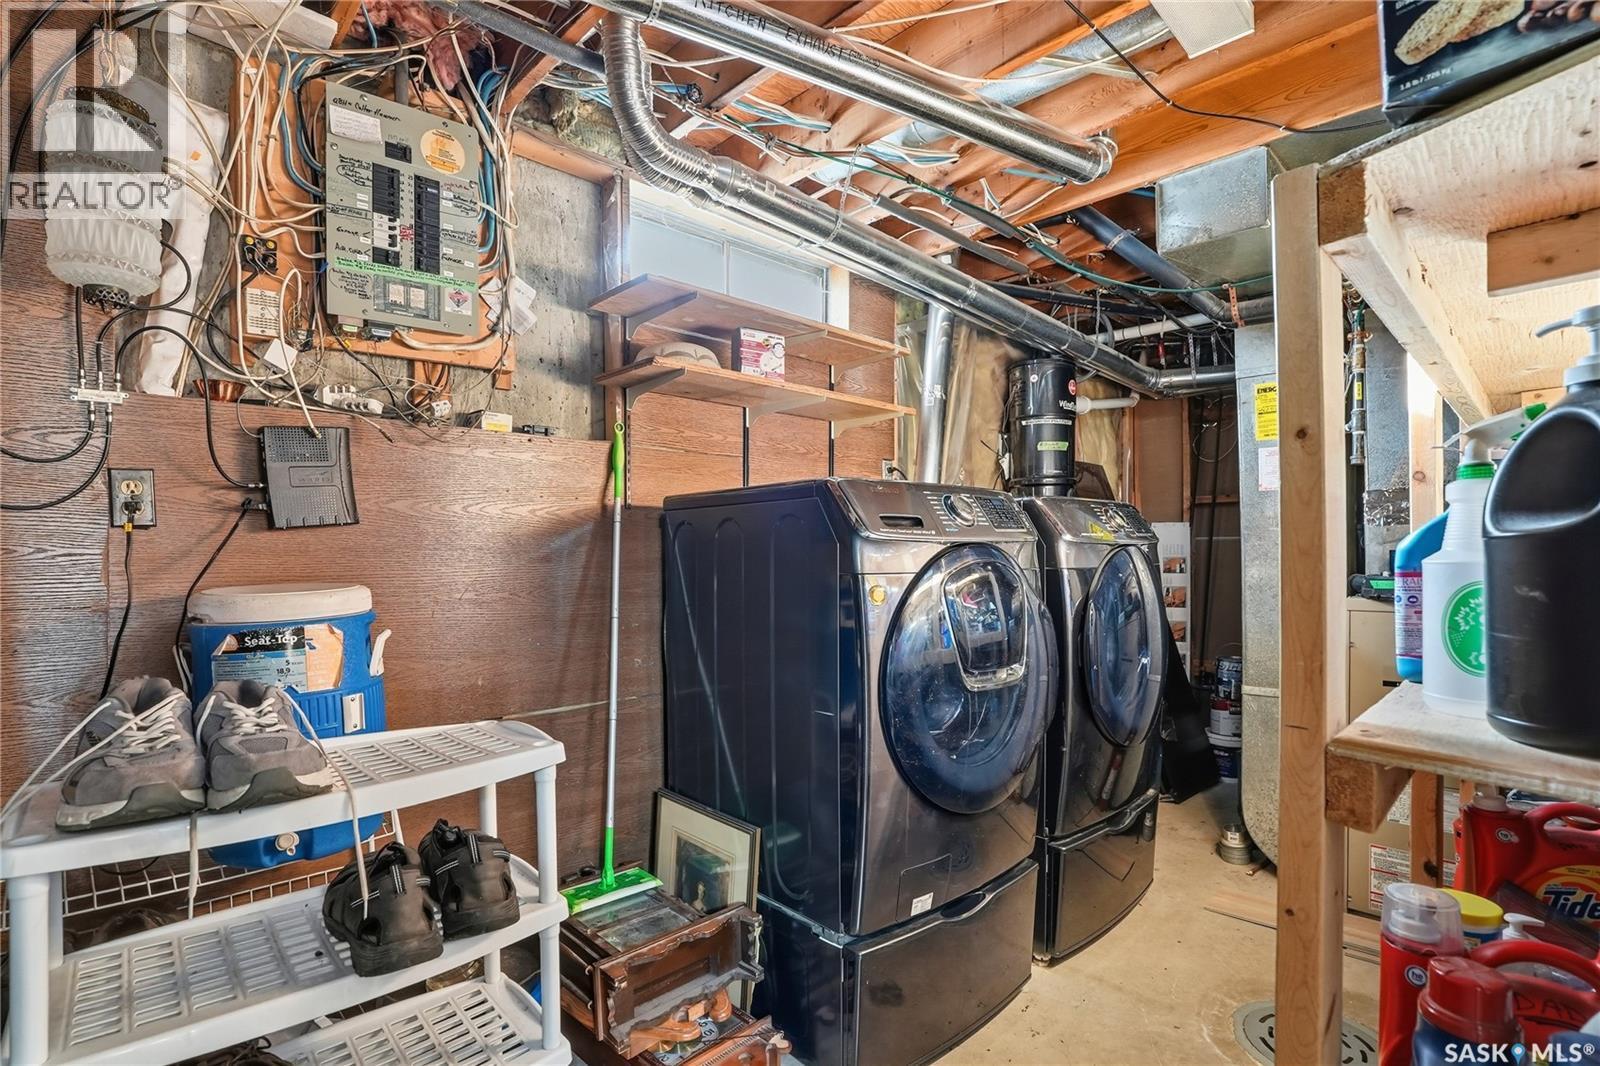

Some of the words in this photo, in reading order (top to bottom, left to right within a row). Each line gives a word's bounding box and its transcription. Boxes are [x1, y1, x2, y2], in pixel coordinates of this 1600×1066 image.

[694, 0, 767, 32] KITCHEN
[785, 26, 844, 61] EXHAUST
[244, 633, 298, 647] Seat-Top
[1543, 887, 1600, 919] Tide
